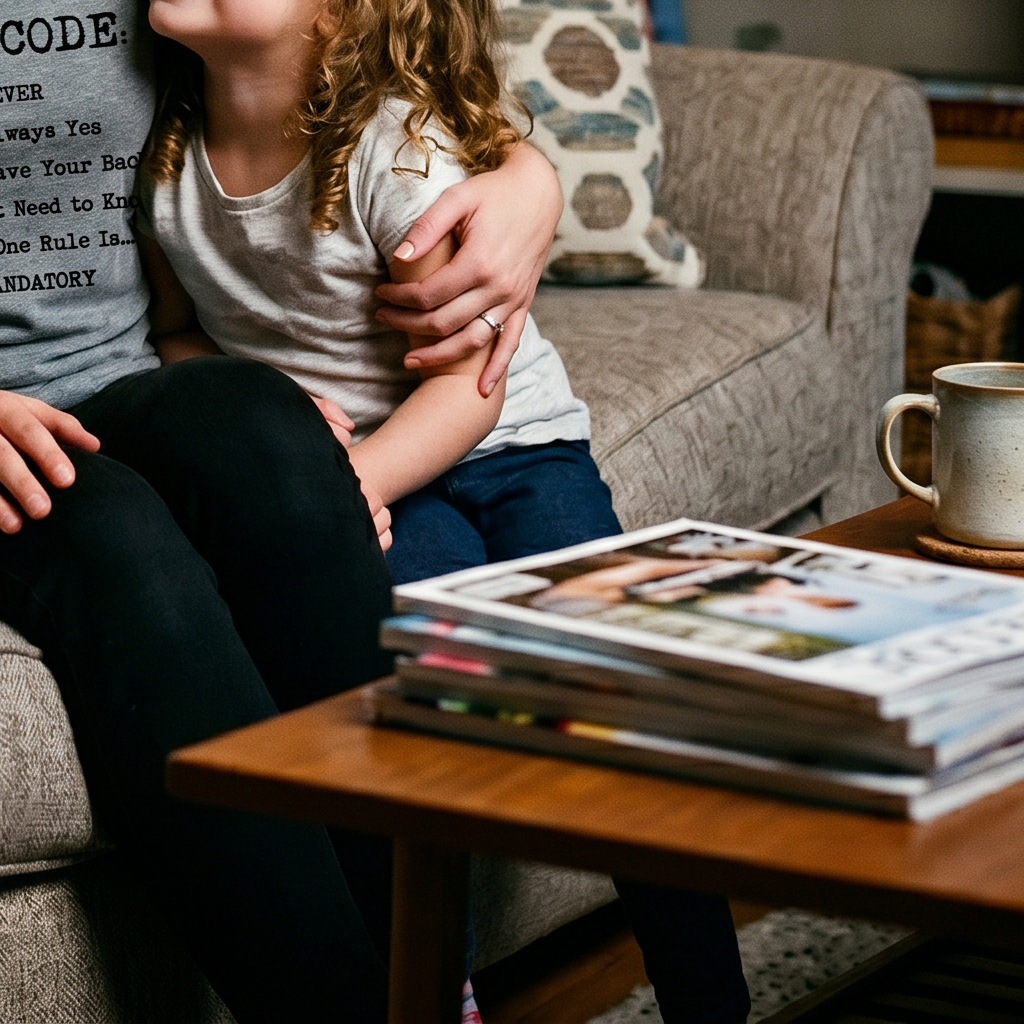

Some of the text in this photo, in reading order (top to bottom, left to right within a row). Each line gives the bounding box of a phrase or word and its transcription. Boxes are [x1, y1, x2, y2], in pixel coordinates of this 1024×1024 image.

[0, 11, 129, 56] CODE:
[65, 120, 103, 138] Yes
[40, 158, 93, 177] Your
[100, 151, 142, 172] Bac
[13, 196, 63, 218] Need
[69, 194, 94, 213] to
[101, 192, 140, 210] Kno
[39, 231, 91, 252] Rule
[98, 230, 136, 248] Is...
